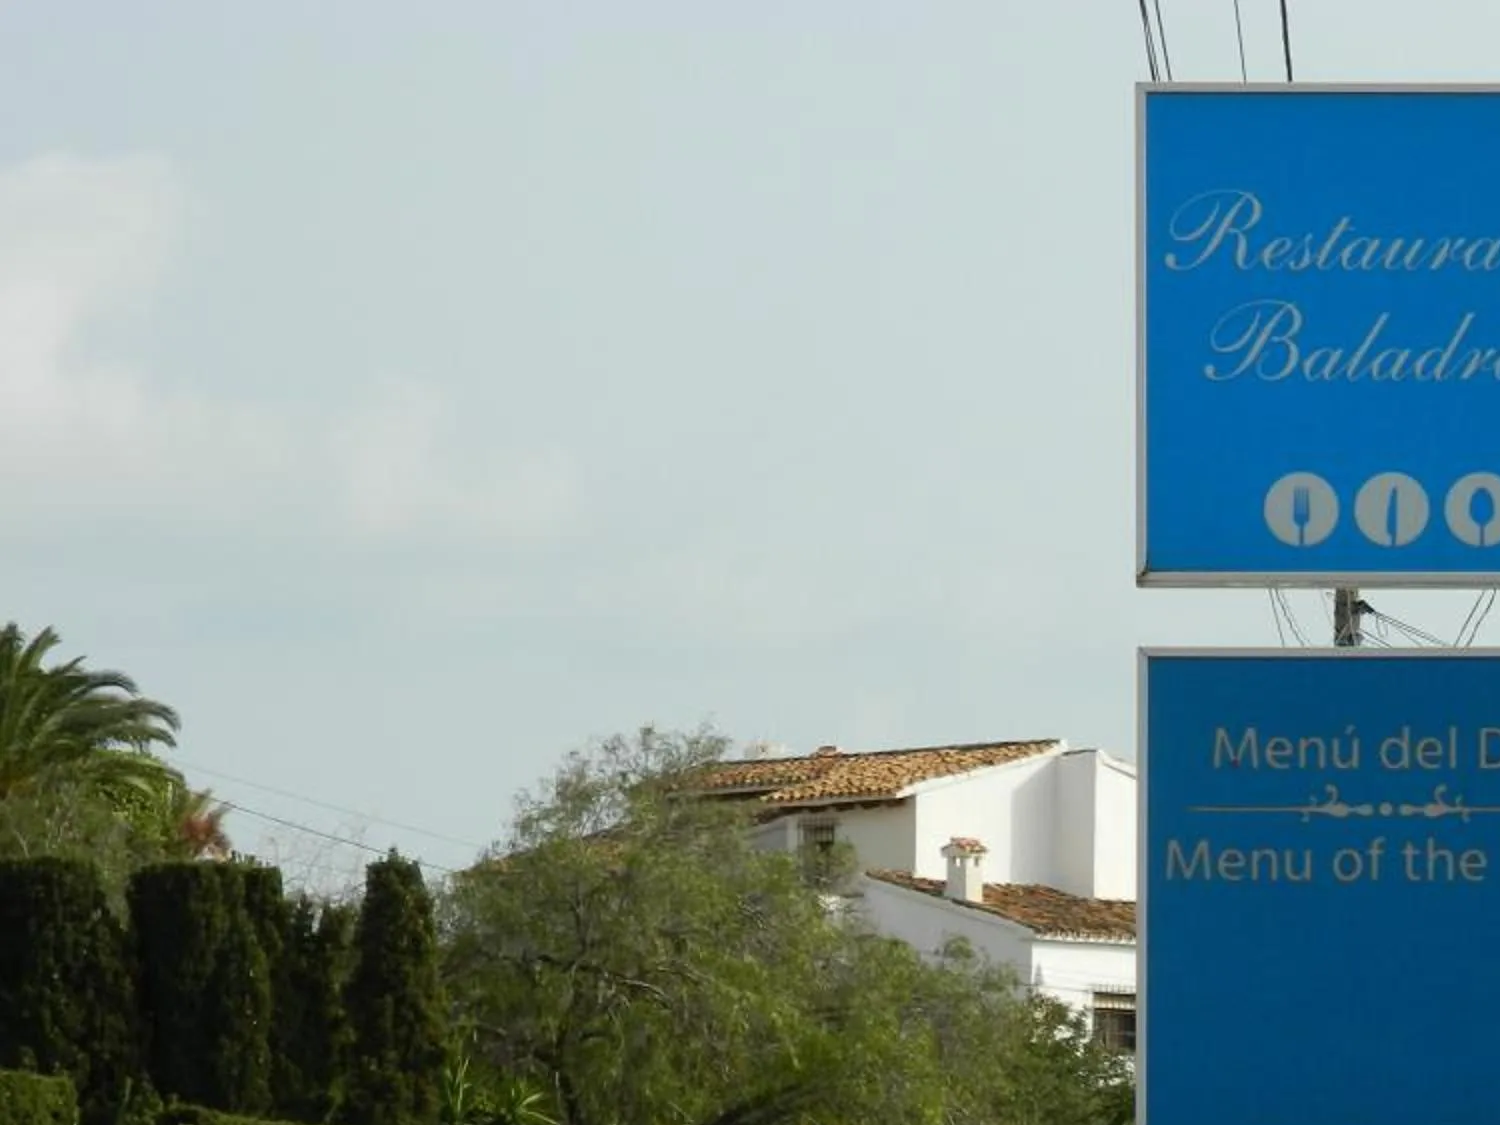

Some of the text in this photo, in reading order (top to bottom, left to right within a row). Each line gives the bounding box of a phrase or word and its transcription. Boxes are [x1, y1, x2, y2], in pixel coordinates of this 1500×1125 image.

[1212, 725, 1360, 770] Menú
[1379, 726, 1457, 770] del
[1165, 839, 1313, 881] Menu
[1332, 836, 1386, 881] of
[1403, 838, 1487, 881] the
